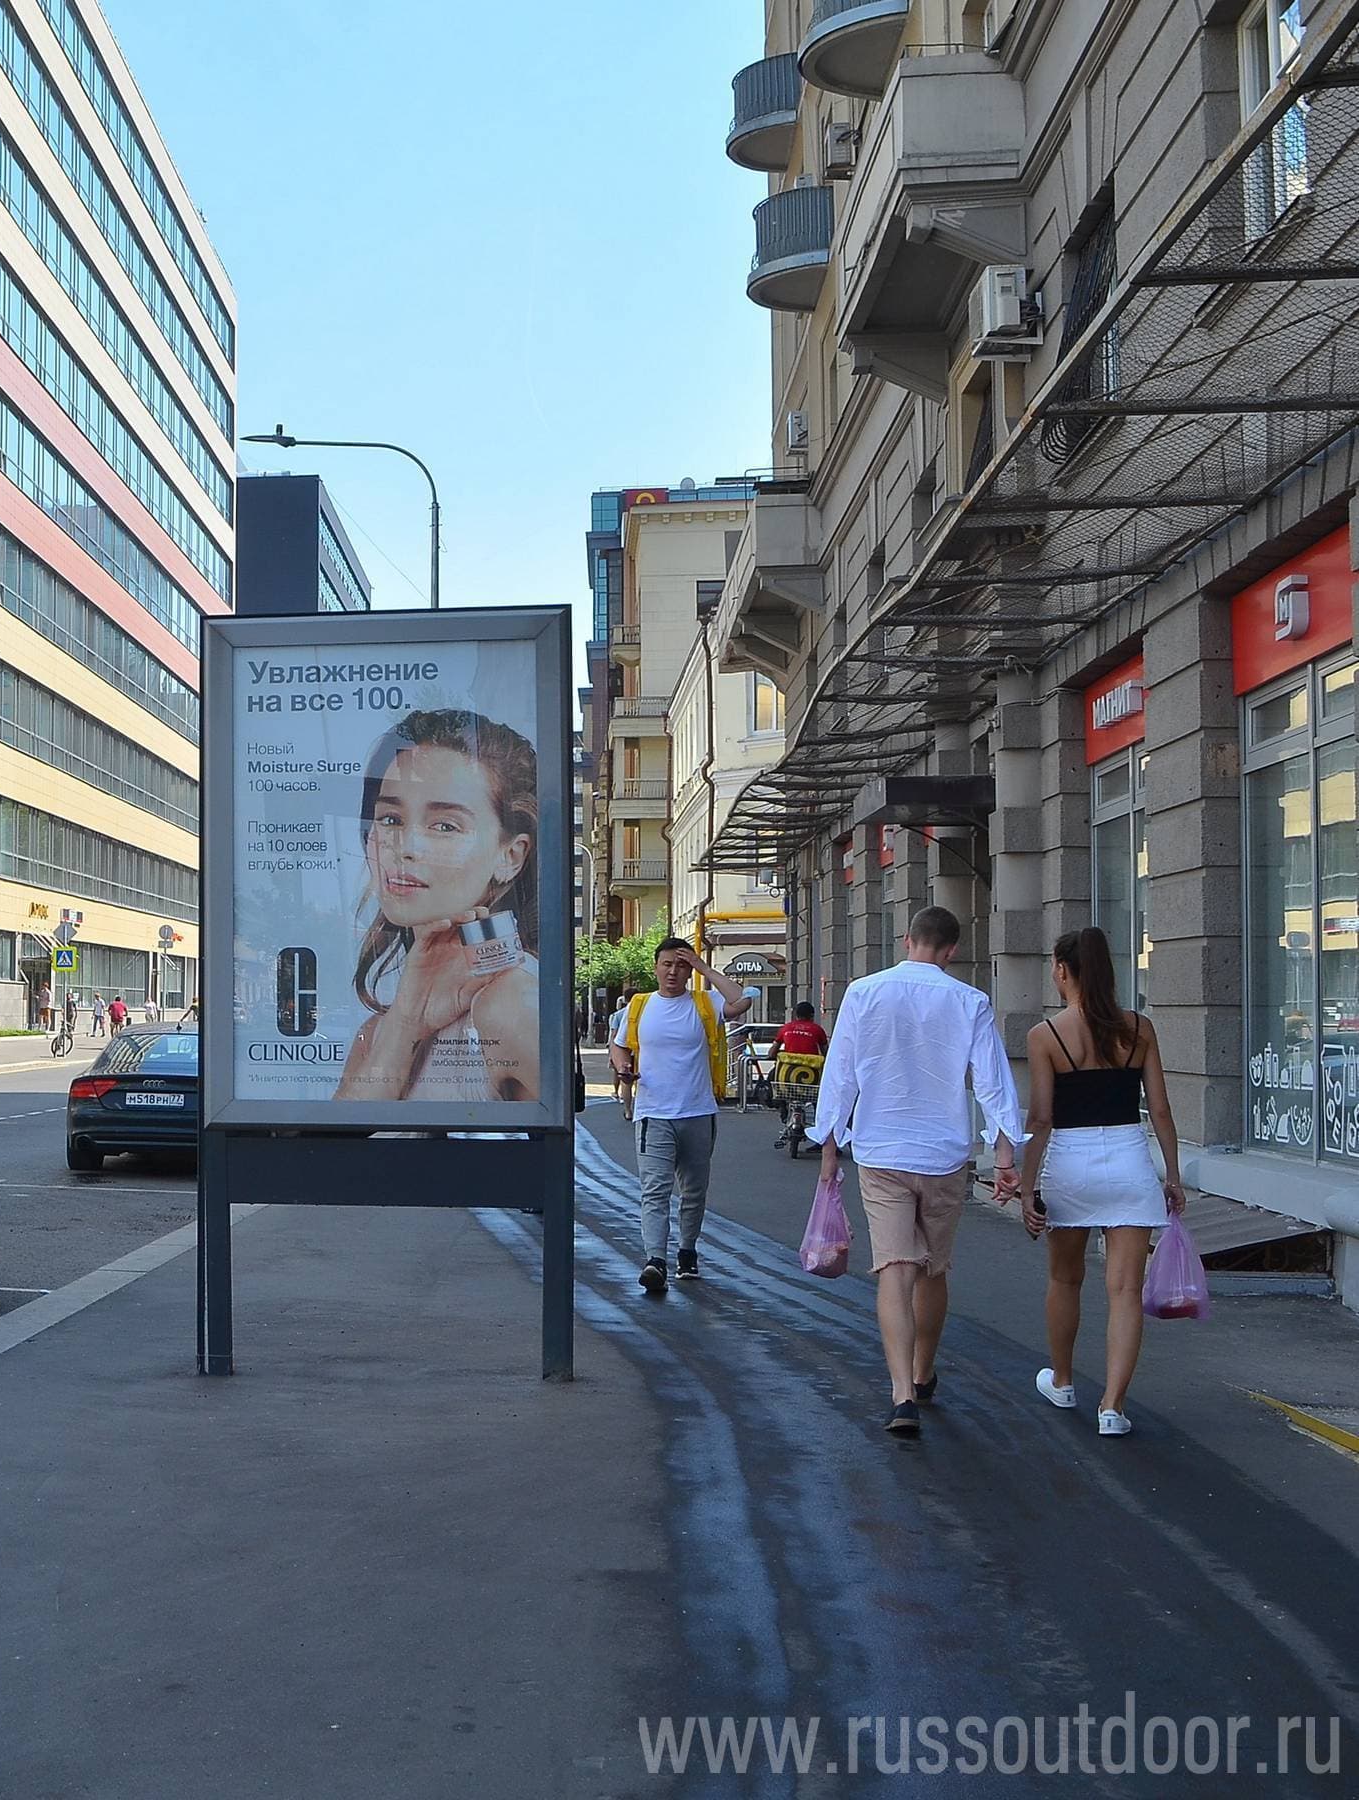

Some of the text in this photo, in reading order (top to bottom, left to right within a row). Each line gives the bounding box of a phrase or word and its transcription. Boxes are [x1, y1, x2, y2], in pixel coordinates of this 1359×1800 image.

[247, 660, 439, 685] Увлажнение
[247, 686, 411, 713] на все 100.
[1092, 680, 1133, 730] МАГНИТ
[247, 741, 294, 755] Новый
[247, 759, 361, 776] Moisture Surge
[248, 779, 321, 793] 100 часов.
[248, 820, 323, 836] Проникает
[248, 839, 328, 852] на 10 слоев
[248, 857, 294, 873] вглубь
[736, 961, 762, 972] ОТЕЛЬ
[432, 1037, 501, 1048] Эмилия Кларк
[248, 1043, 345, 1065] CLINIQUE
